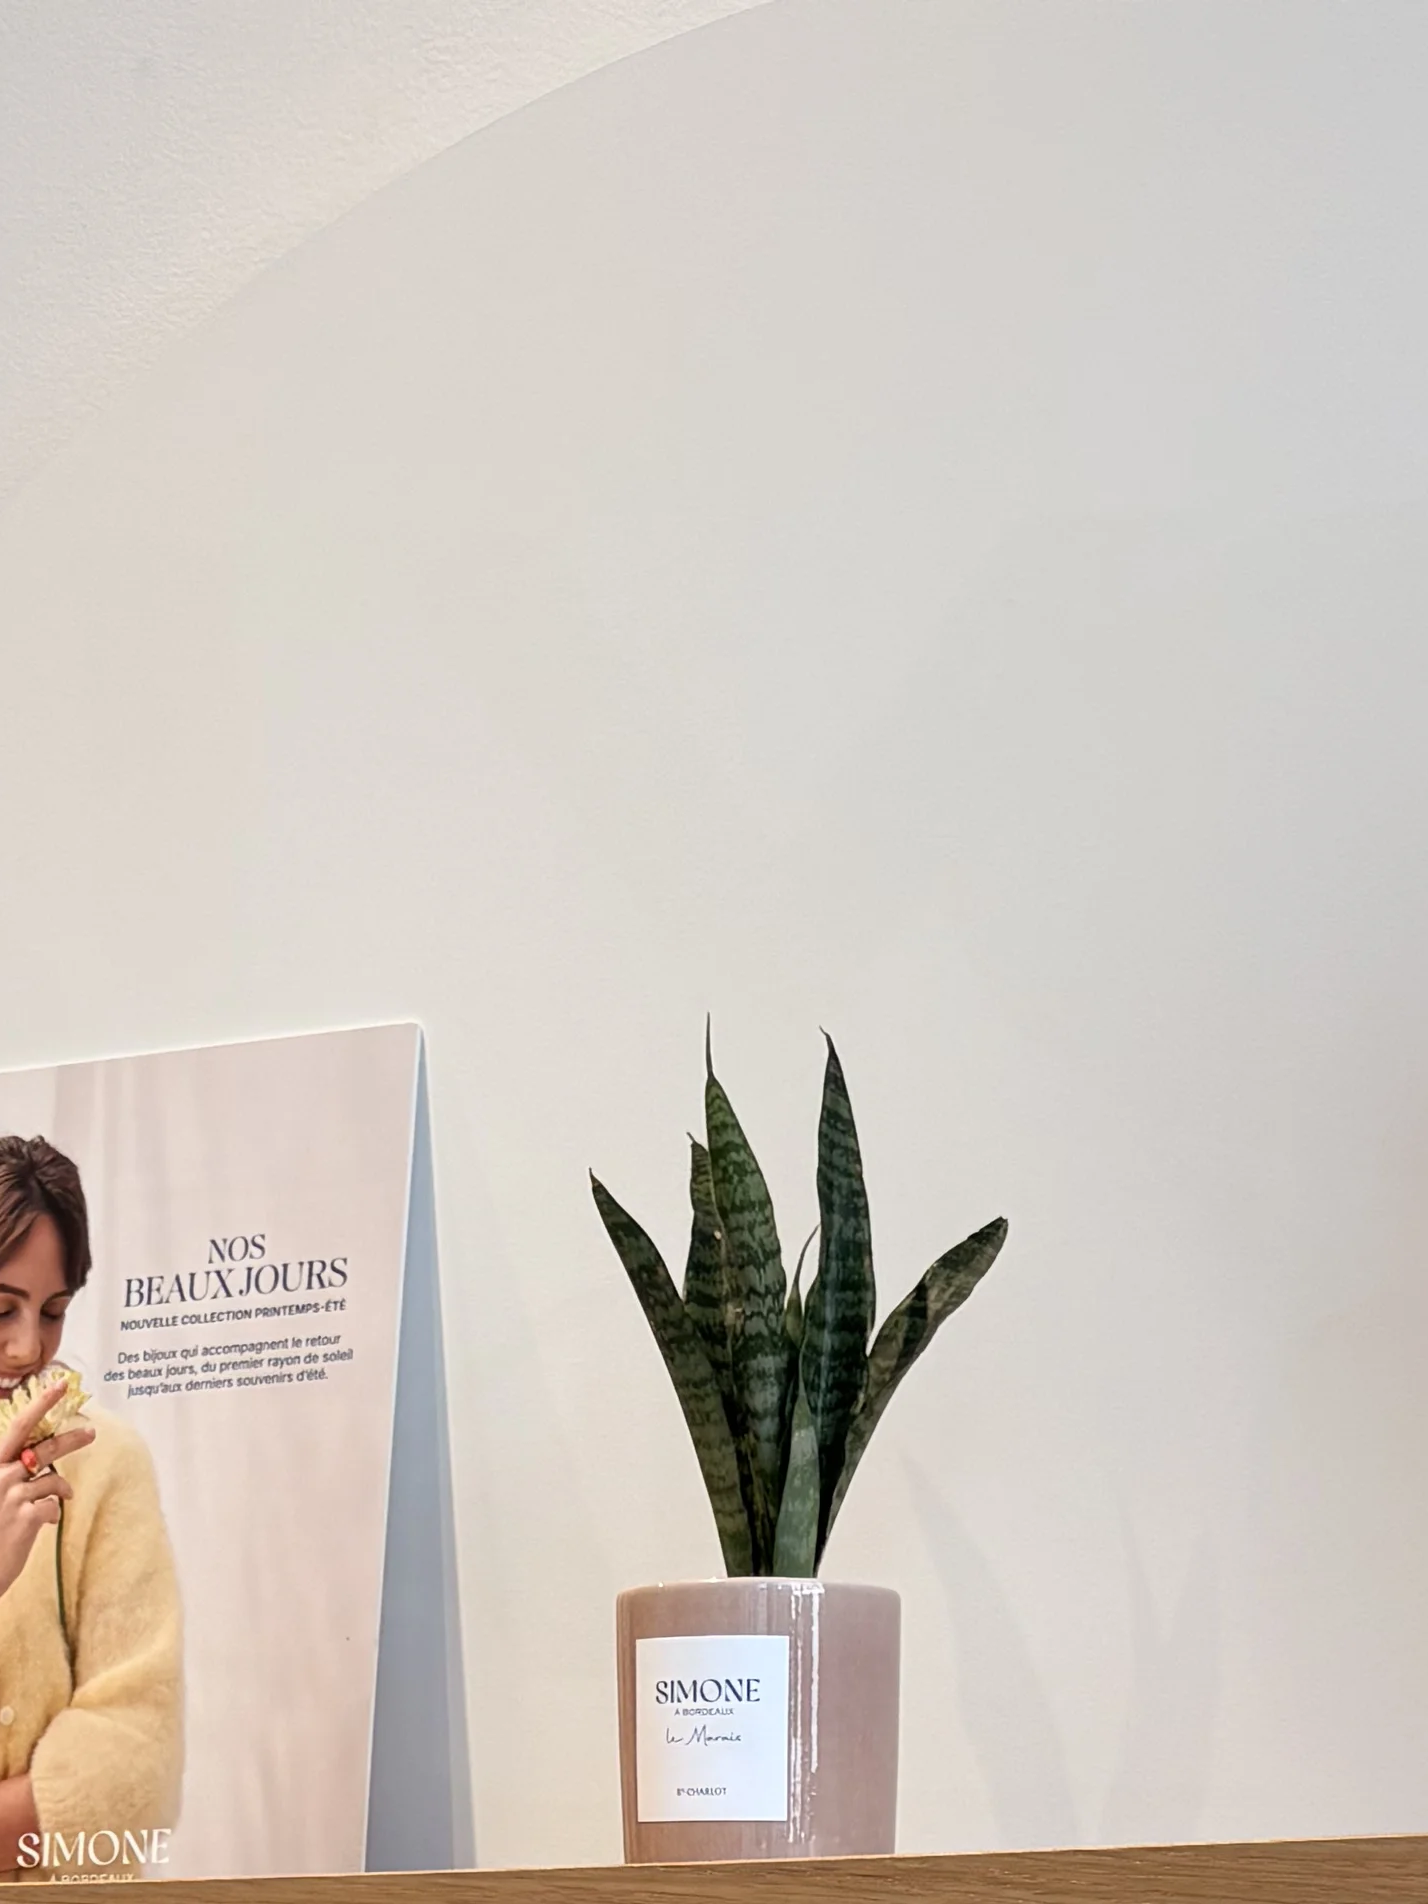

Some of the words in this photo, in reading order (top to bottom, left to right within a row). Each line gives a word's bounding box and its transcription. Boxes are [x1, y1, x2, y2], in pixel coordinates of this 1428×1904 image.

[208, 1234, 266, 1264] NOS
[124, 1267, 235, 1307] BEAUX
[238, 1257, 348, 1298] JOURS
[121, 1315, 178, 1331] NOUVELLE
[181, 1309, 252, 1325] COLLECTION
[118, 1352, 140, 1364] Des
[143, 1348, 177, 1363] bijoux
[180, 1345, 199, 1361] qui
[201, 1338, 289, 1356] accompagnent
[291, 1336, 302, 1349] le
[305, 1334, 341, 1347] retour
[103, 1370, 124, 1382] des
[127, 1366, 162, 1380] beaux
[164, 1363, 198, 1379] jours,
[201, 1361, 217, 1374] du
[219, 1357, 264, 1374] premier
[267, 1354, 301, 1369] rayon
[303, 1352, 320, 1364] de
[322, 1348, 354, 1361] soleil
[127, 1381, 182, 1399] jusqu'aux
[185, 1377, 233, 1392] derniers
[237, 1373, 294, 1387] souvenirs
[656, 1678, 760, 1704] SIMONE
[682, 1707, 734, 1716] BORDEAUX
[685, 1724, 742, 1746] Marais
[16, 1828, 172, 1868] SIMONE
